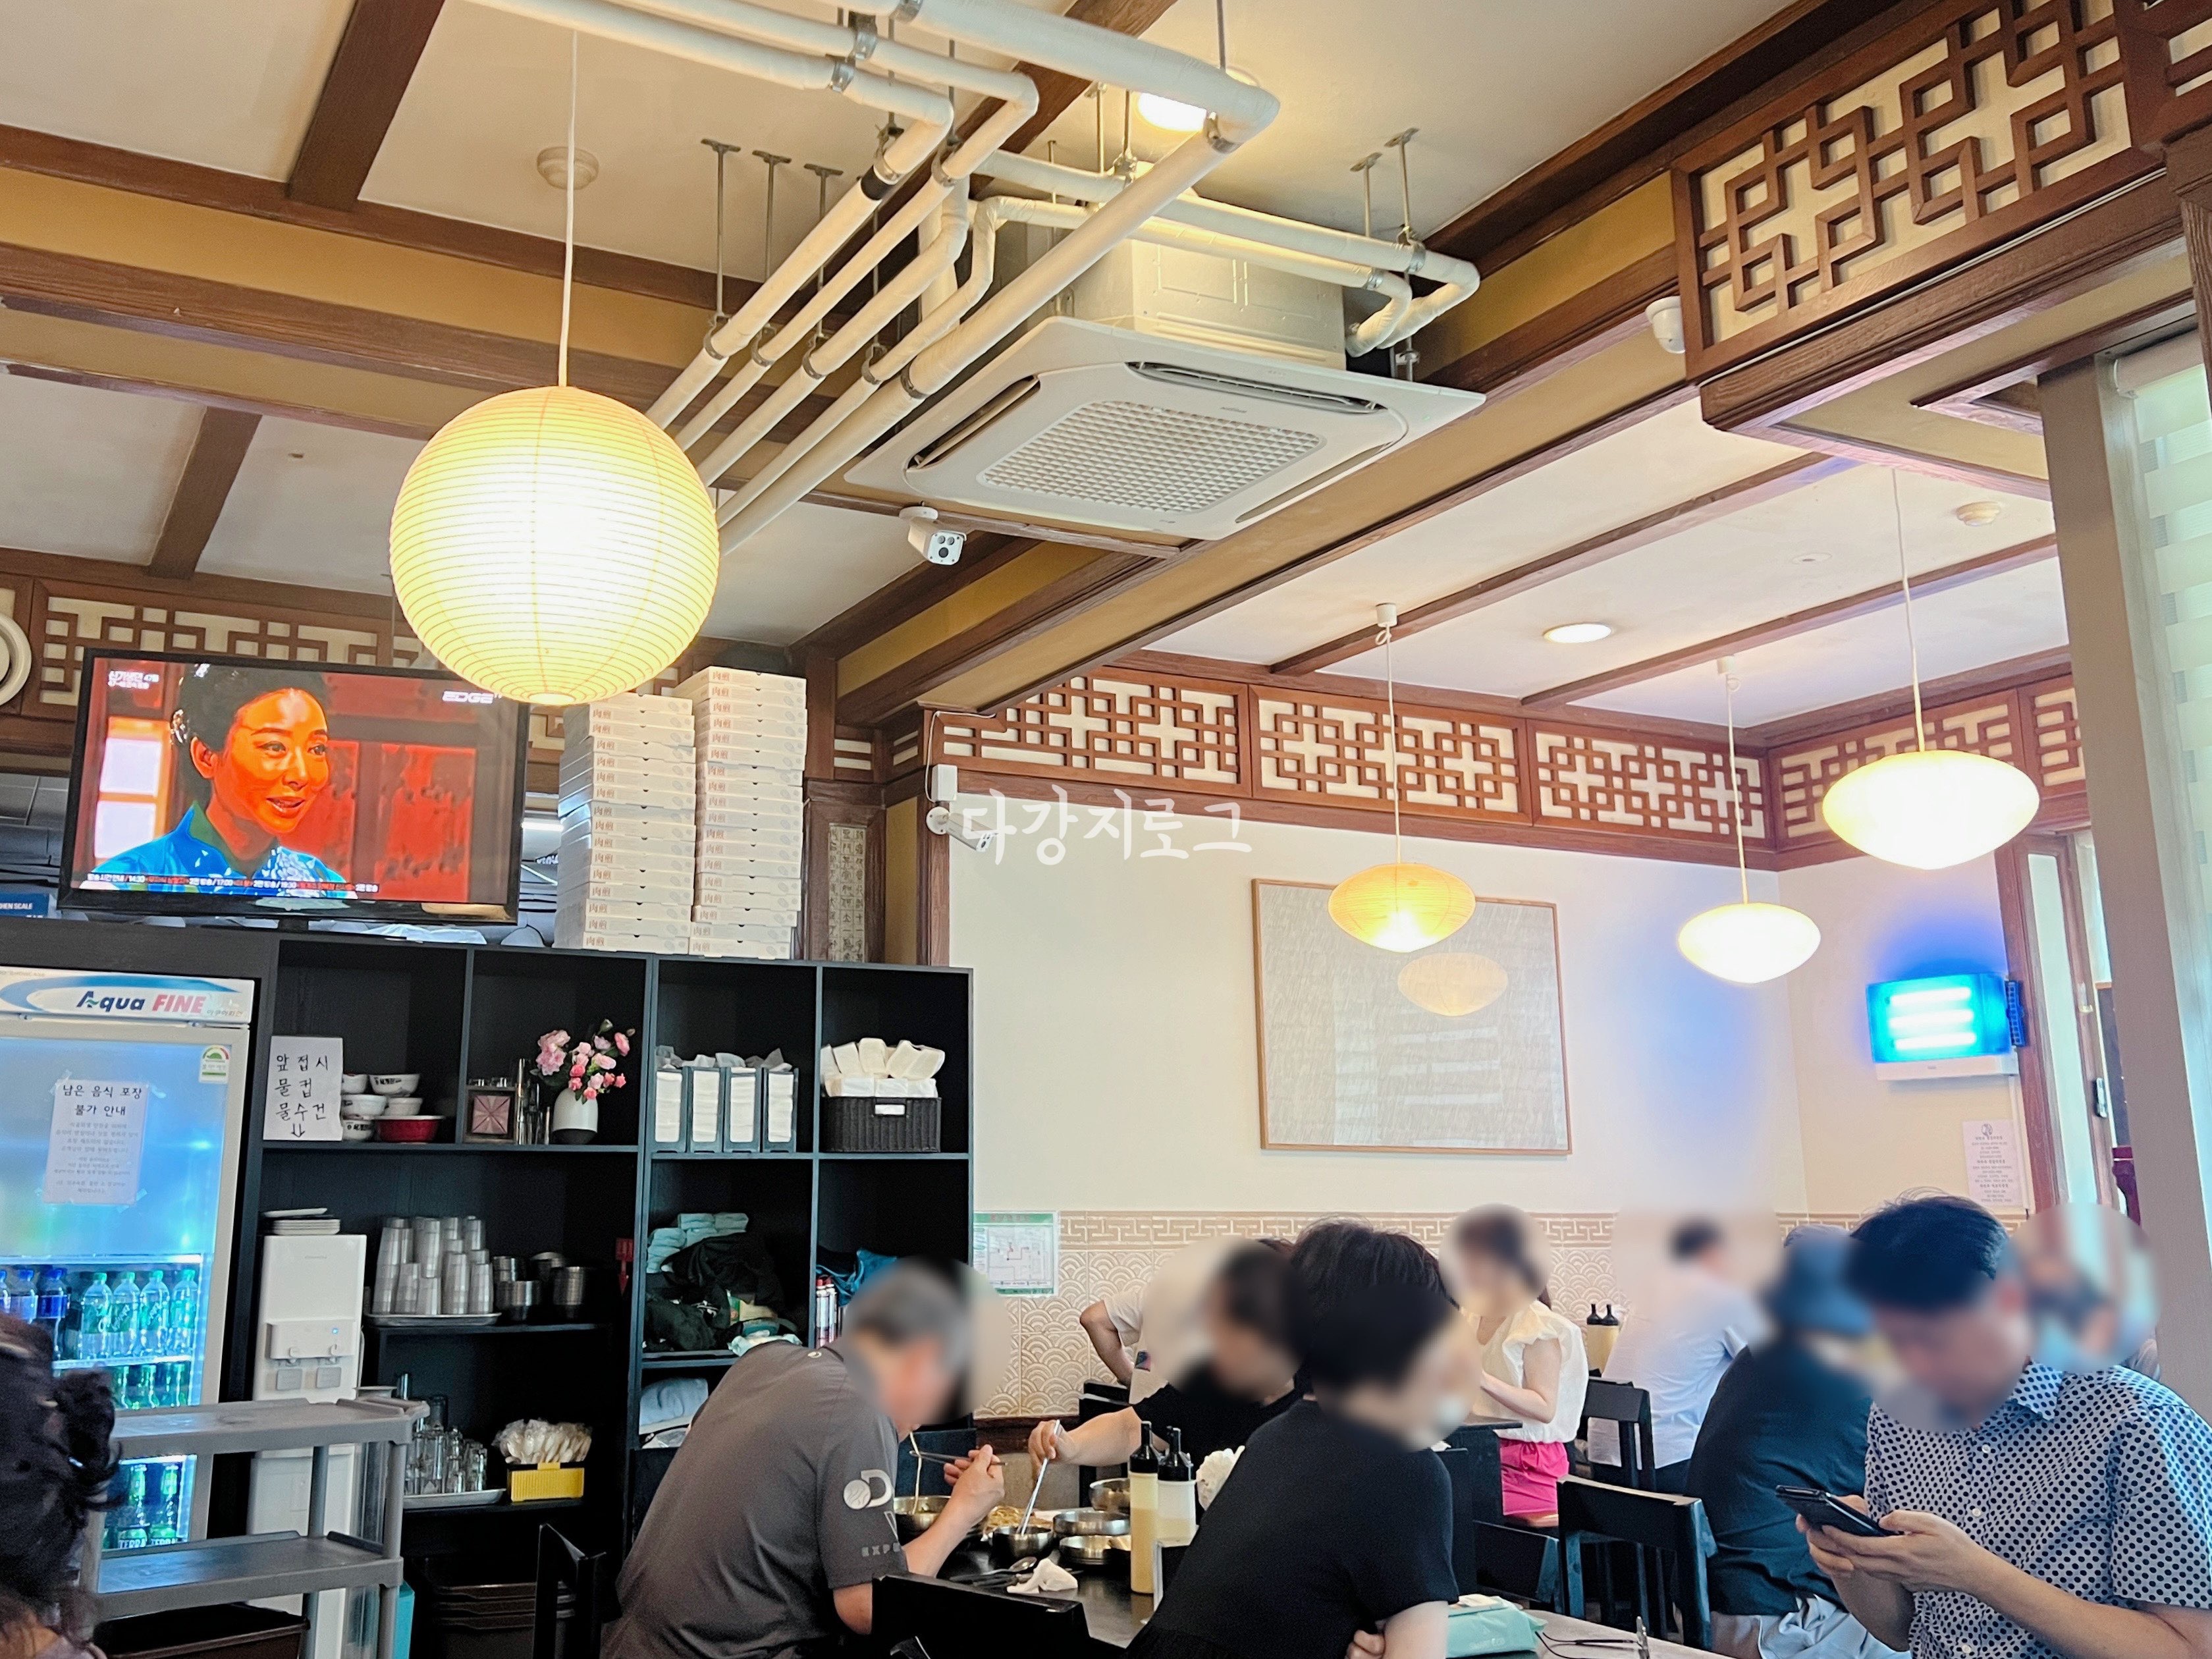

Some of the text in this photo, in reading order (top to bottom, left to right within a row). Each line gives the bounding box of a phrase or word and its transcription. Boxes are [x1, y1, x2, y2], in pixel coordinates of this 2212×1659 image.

[443, 691, 494, 704] EDGE
[77, 991, 206, 1014] Aqua FINE
[275, 1054, 329, 1073] 앞접시
[63, 1085, 142, 1099] 남은 음식 포장
[275, 1078, 313, 1099] 물컵
[75, 1104, 126, 1118] 불가 안내
[275, 1102, 327, 1122] 물수건
